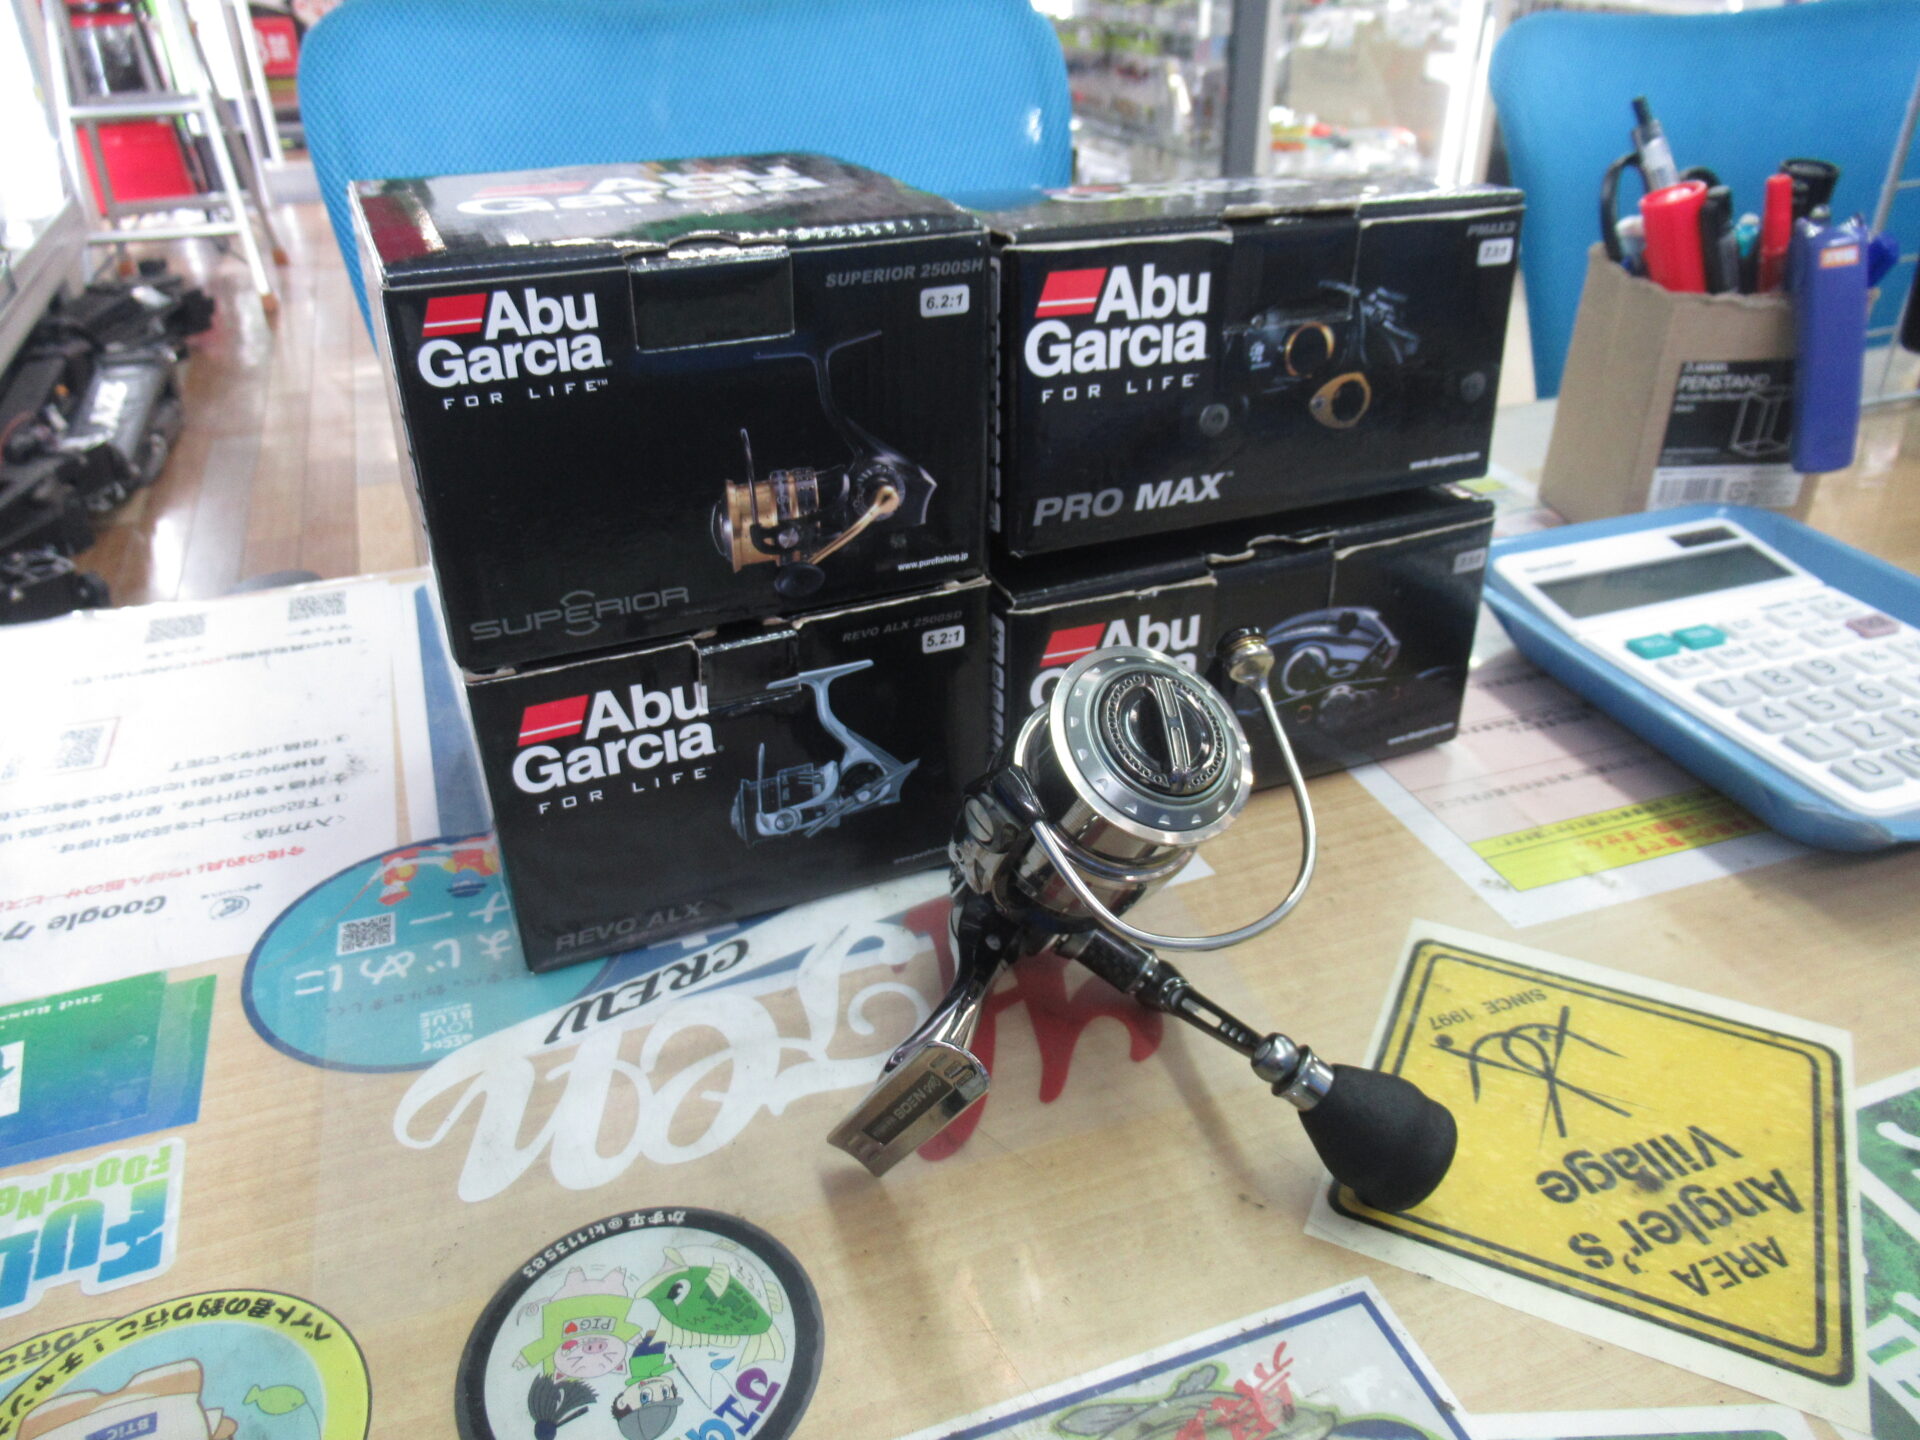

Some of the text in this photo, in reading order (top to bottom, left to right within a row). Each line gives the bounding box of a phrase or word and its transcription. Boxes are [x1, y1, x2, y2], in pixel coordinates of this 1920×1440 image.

[456, 176, 827, 215] Garcia
[590, 165, 800, 196] Abu
[825, 258, 983, 287] SUPERIOR 2500SH
[1095, 264, 1211, 323] Abu
[484, 288, 599, 341] Abu
[926, 293, 963, 310] 6.2:1
[417, 334, 606, 388] Garcia
[1024, 316, 1207, 378] Garcia
[443, 392, 503, 411] FOR
[1042, 373, 1195, 404] FOR LIFE
[1033, 472, 1226, 526] PRO MAX
[898, 552, 968, 571] www.purefishing.jp
[470, 586, 690, 641] SUPERIOR
[842, 626, 879, 642] REVO
[884, 620, 910, 633] ALX
[1102, 614, 1200, 651] Abu
[926, 629, 960, 648] 5.2:1
[585, 683, 710, 740] Abu
[511, 721, 717, 795] Garcia
[539, 767, 708, 815] FOR LIFE
[47, 895, 167, 930] Google
[555, 902, 703, 951] REVO ALX
[544, 939, 750, 1045] CREW
[1430, 988, 1547, 1032] SINCE 1997
[1535, 1125, 1744, 1205] Village
[1669, 1235, 1790, 1297] AREA
[579, 1317, 613, 1332] PIG
